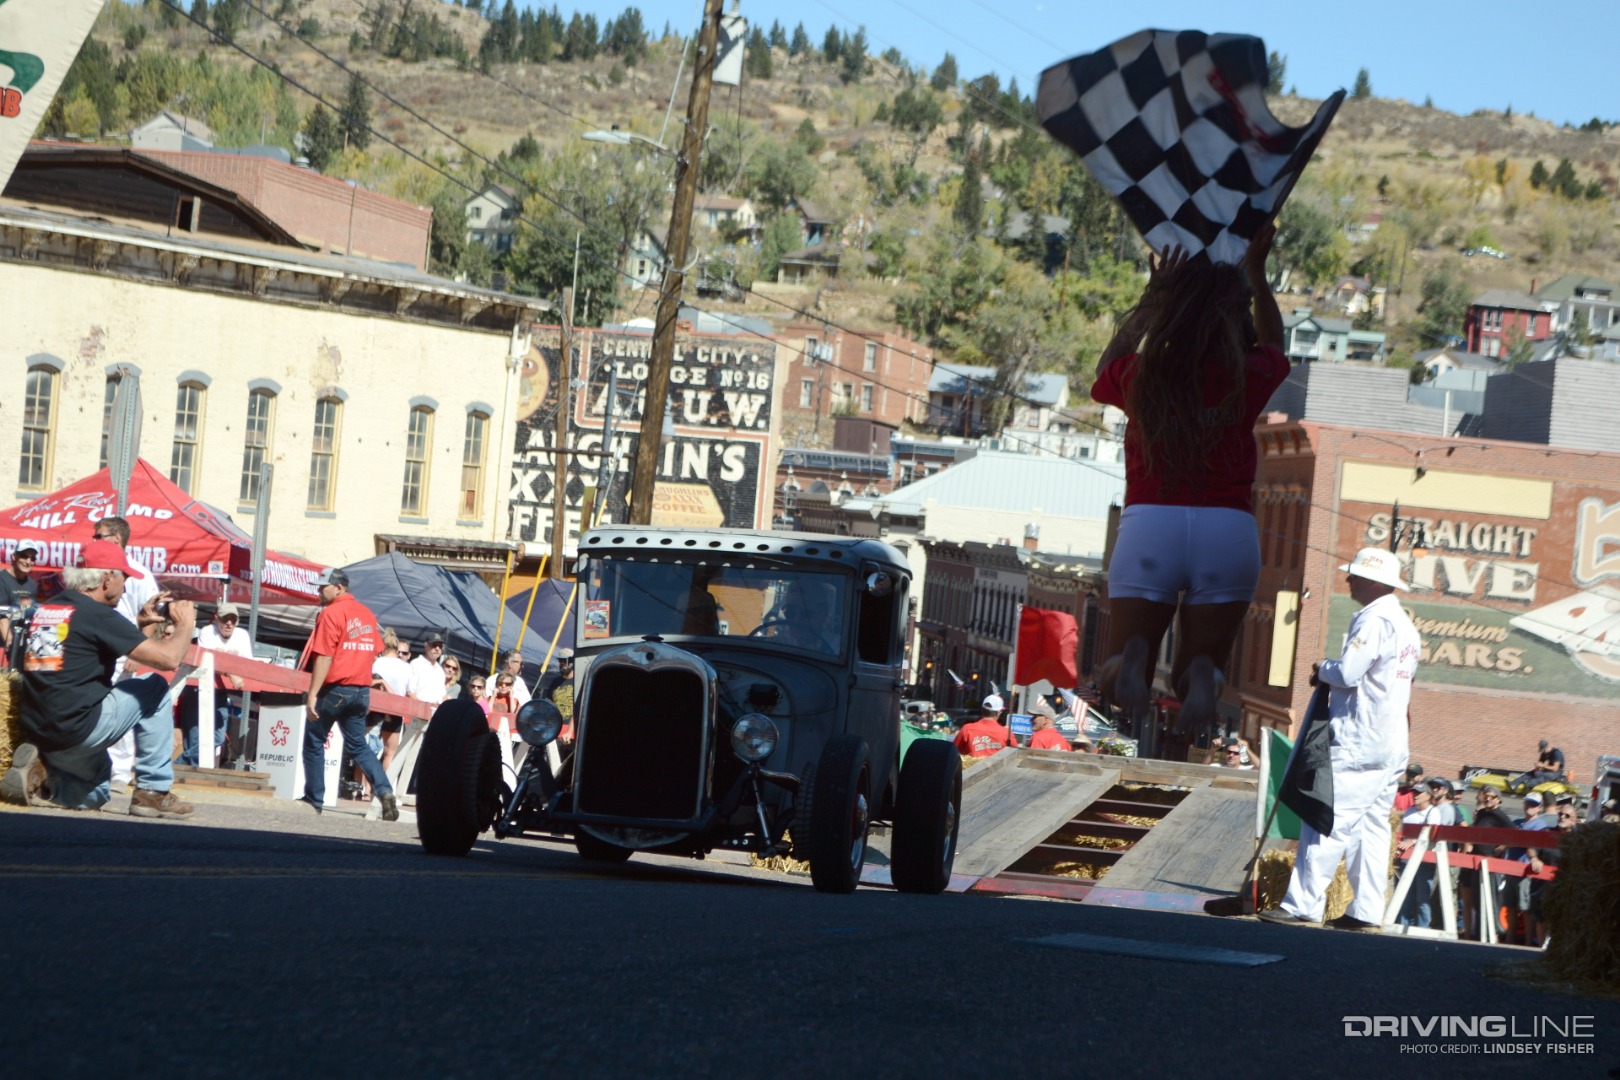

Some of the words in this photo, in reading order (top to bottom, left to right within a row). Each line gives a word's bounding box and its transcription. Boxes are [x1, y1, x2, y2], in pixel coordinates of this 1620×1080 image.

[603, 337, 685, 362] CENTL
[697, 346, 747, 365] CITY
[615, 361, 707, 386] LOGE
[747, 370, 769, 390] 16
[512, 429, 746, 482] AUGHIN'S
[87, 503, 173, 522] CLMB
[653, 502, 706, 514] COFFEE
[1367, 512, 1538, 557] STRAIGHT
[343, 642, 356, 650] PIT
[260, 753, 294, 763] REPUBLIC
